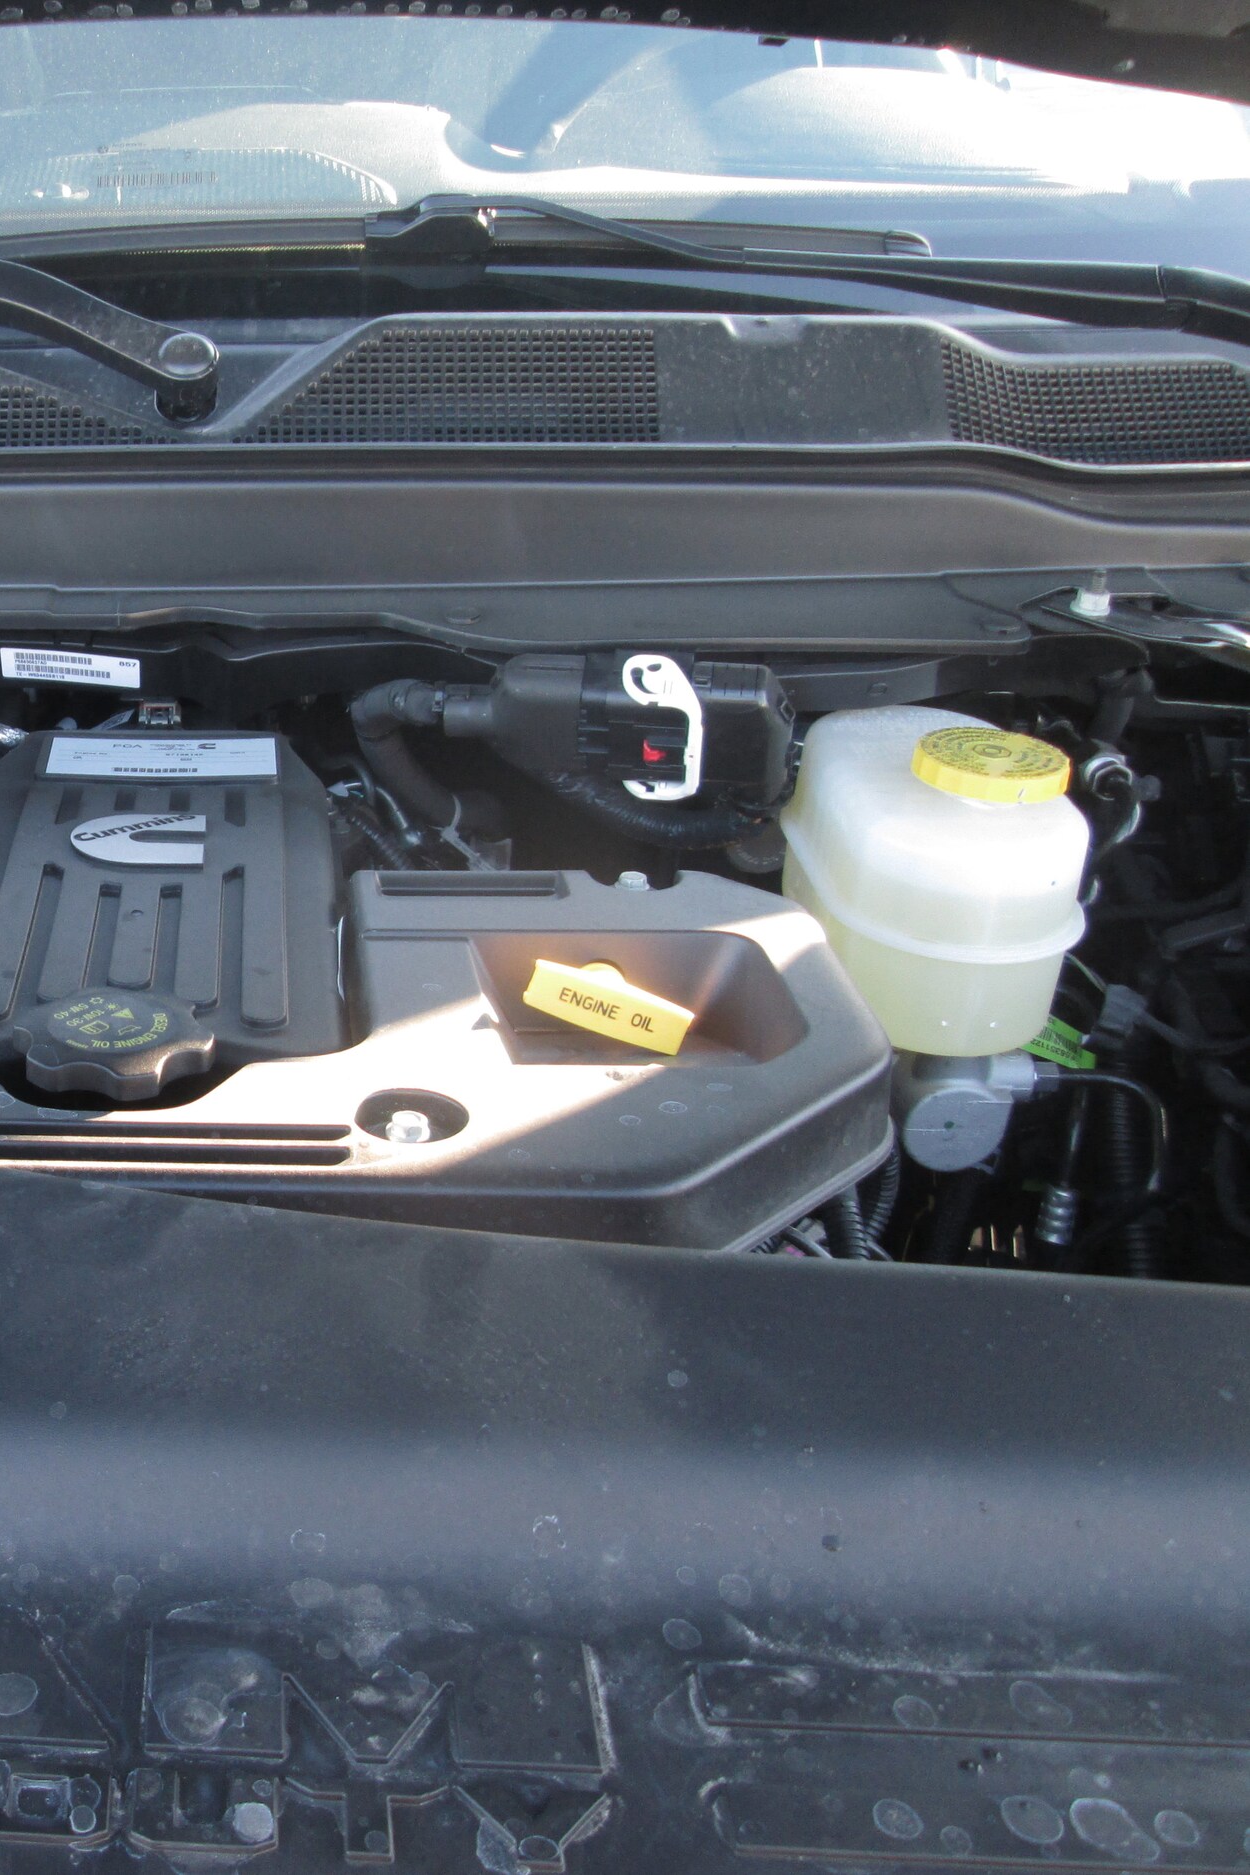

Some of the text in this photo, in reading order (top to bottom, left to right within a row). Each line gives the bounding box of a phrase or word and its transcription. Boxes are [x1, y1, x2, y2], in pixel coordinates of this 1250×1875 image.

[73, 814, 196, 841] Cummins
[559, 987, 654, 1033] ENGINE OIL
[91, 1039, 111, 1048] OIL
[113, 1032, 157, 1048] ENGINE
